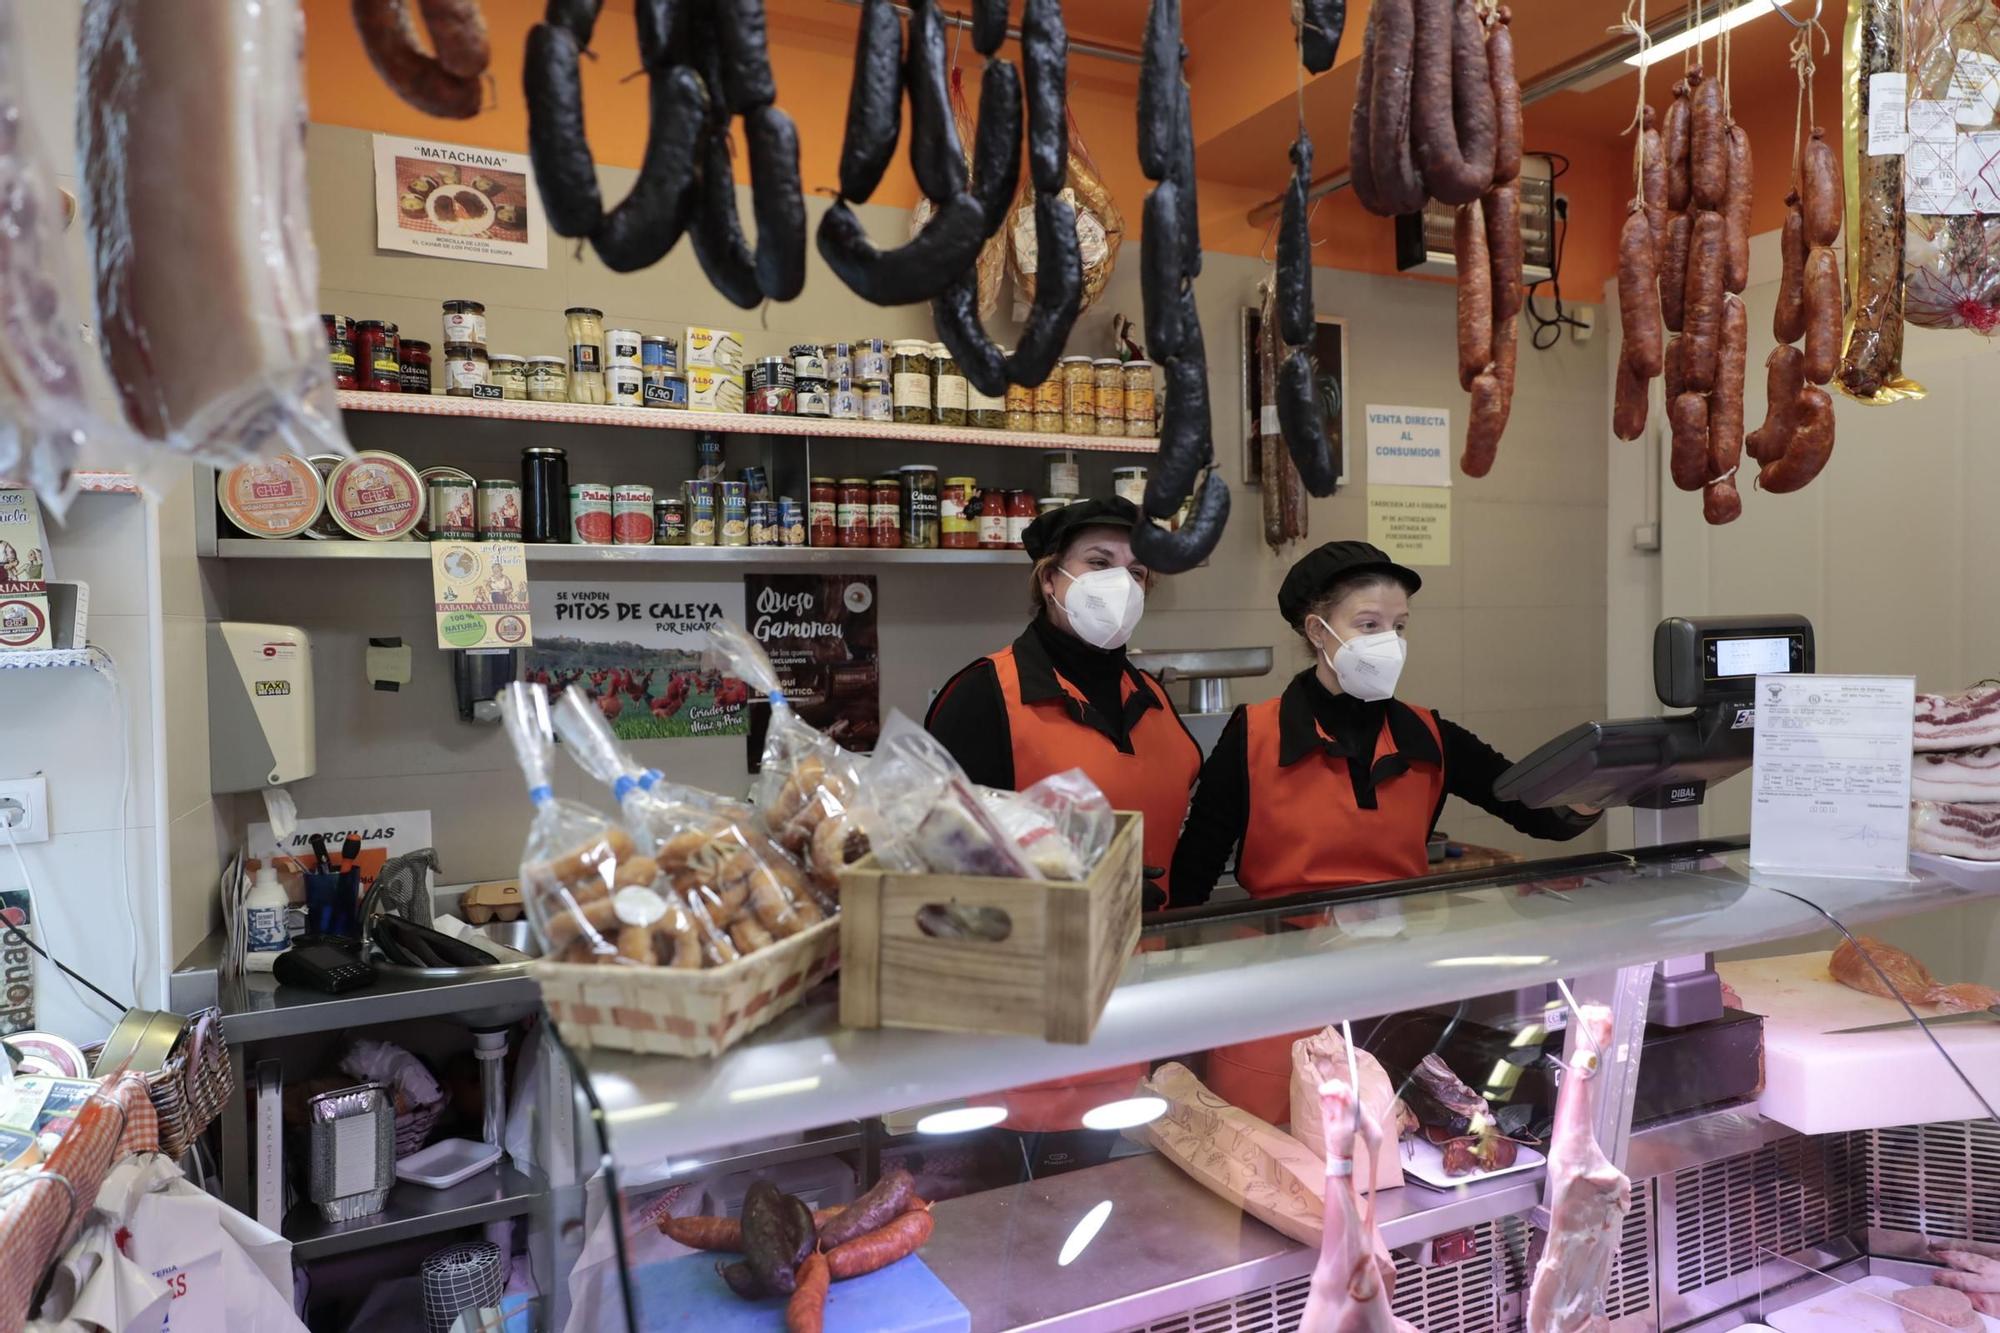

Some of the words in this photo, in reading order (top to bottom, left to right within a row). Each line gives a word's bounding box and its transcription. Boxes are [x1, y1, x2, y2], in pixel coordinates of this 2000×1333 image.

[690, 333, 713, 342] ALBO
[692, 376, 714, 385] ALBO
[475, 385, 501, 397] 2,35
[648, 386, 671, 400] 6,90
[1369, 413, 1402, 425] VENTA
[1405, 415, 1446, 427] DIRECTA
[1401, 431, 1414, 441] AL
[1375, 446, 1441, 458] CONSUMIDOR
[256, 484, 288, 497] CHEF
[361, 488, 390, 503] CHEF
[616, 493, 651, 502] Palacio
[722, 496, 747, 507] VITER
[556, 592, 568, 601] SE
[571, 592, 610, 601] VENDEN
[756, 586, 814, 617] Queso
[439, 603, 474, 611] FABADA
[477, 603, 527, 611] ASTURIANA
[555, 603, 610, 620] PITOS
[616, 602, 642, 621] DE
[649, 602, 724, 621] CALEYA
[445, 622, 482, 633] NATURAL
[656, 622, 683, 635] POR
[680, 622, 717, 633] ENCAR
[753, 615, 845, 642] Gamoneu
[261, 682, 285, 690] TAXI
[690, 703, 724, 720] Criados
[1671, 787, 1696, 799] DIBAL
[292, 827, 396, 847] MRCLAS
